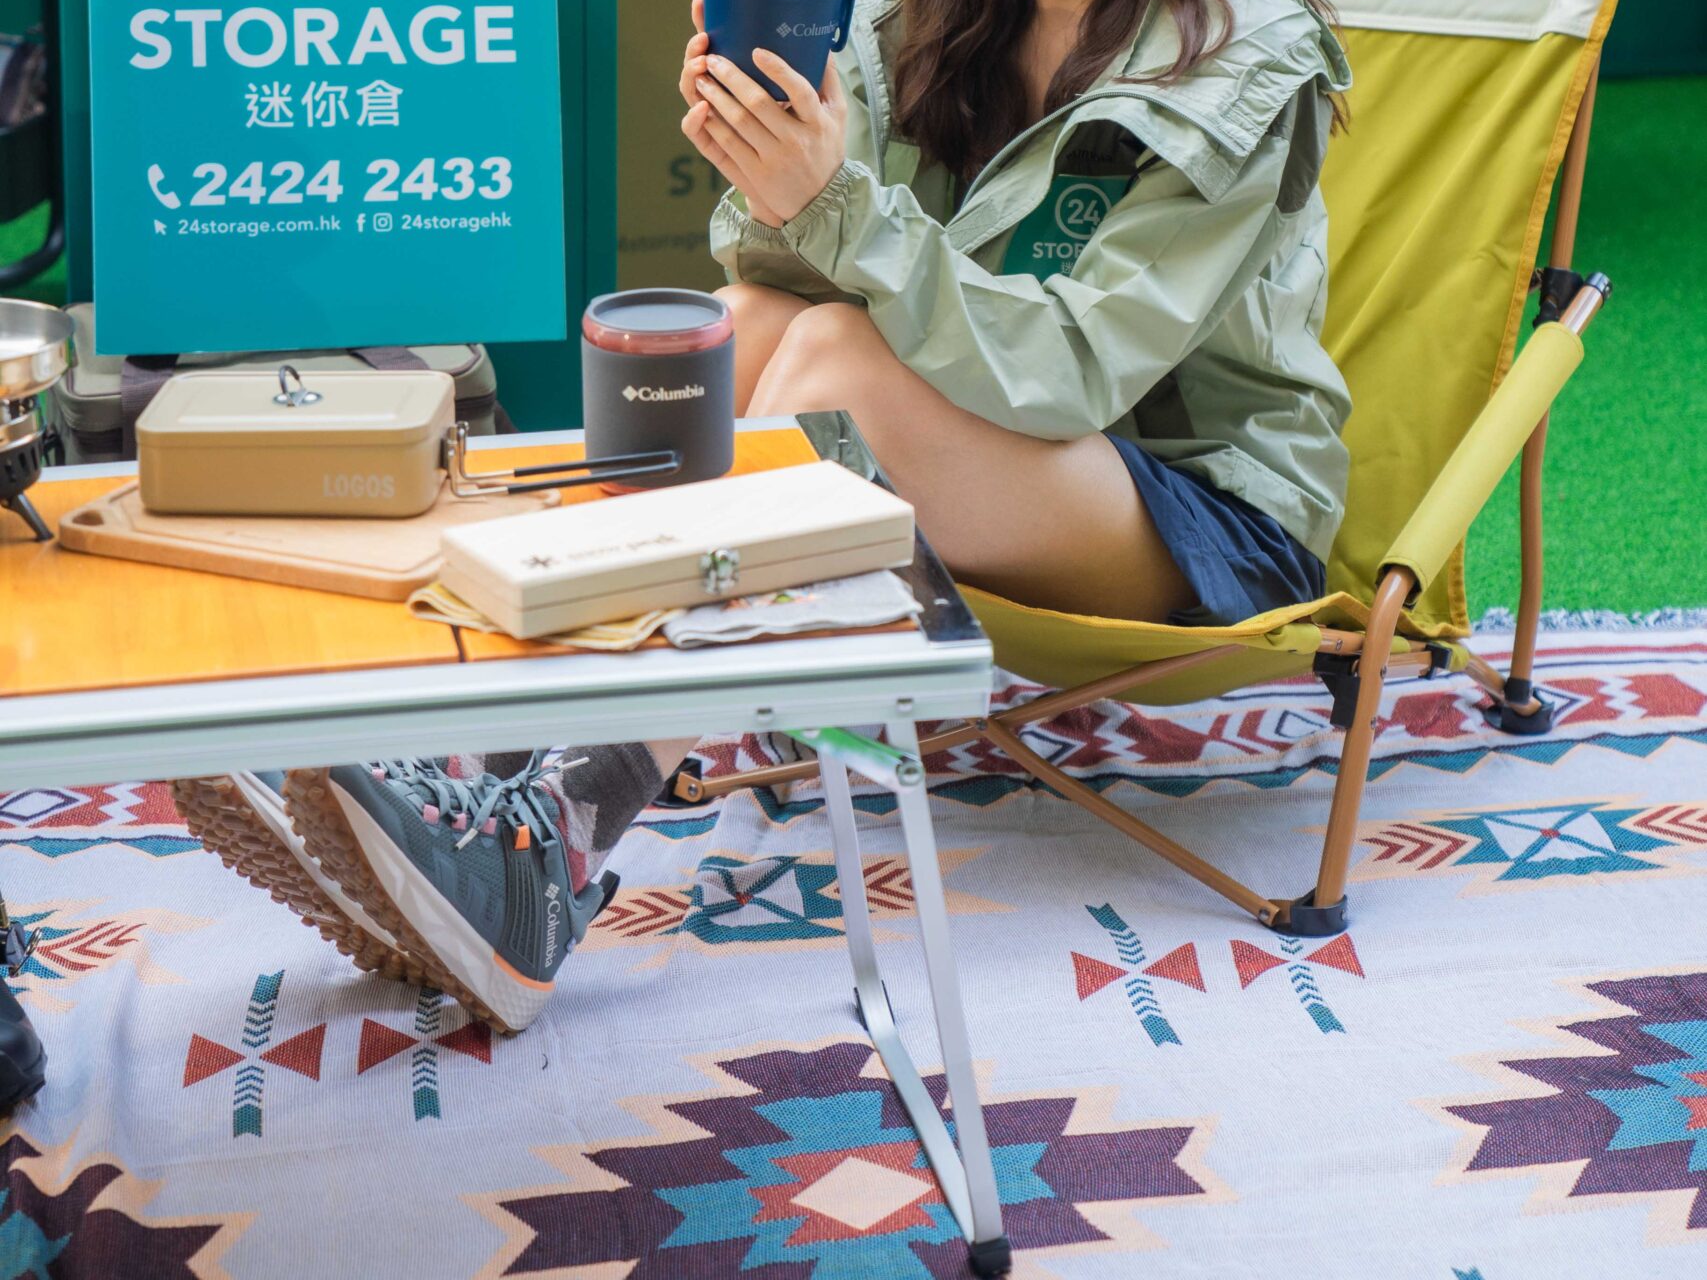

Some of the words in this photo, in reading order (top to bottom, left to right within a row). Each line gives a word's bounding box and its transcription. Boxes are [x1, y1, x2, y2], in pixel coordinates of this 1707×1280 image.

[129, 5, 517, 70] STORAGE
[245, 79, 404, 128] 迷你倉
[190, 160, 344, 206] 2424
[363, 156, 513, 202] 2433
[177, 215, 341, 238] 24storage.com.hk
[401, 212, 512, 233] 24storagehk
[1067, 198, 1100, 225] 24
[638, 384, 705, 402] Columbia
[323, 474, 396, 499] LOGOS
[544, 900, 561, 968] Columbia
